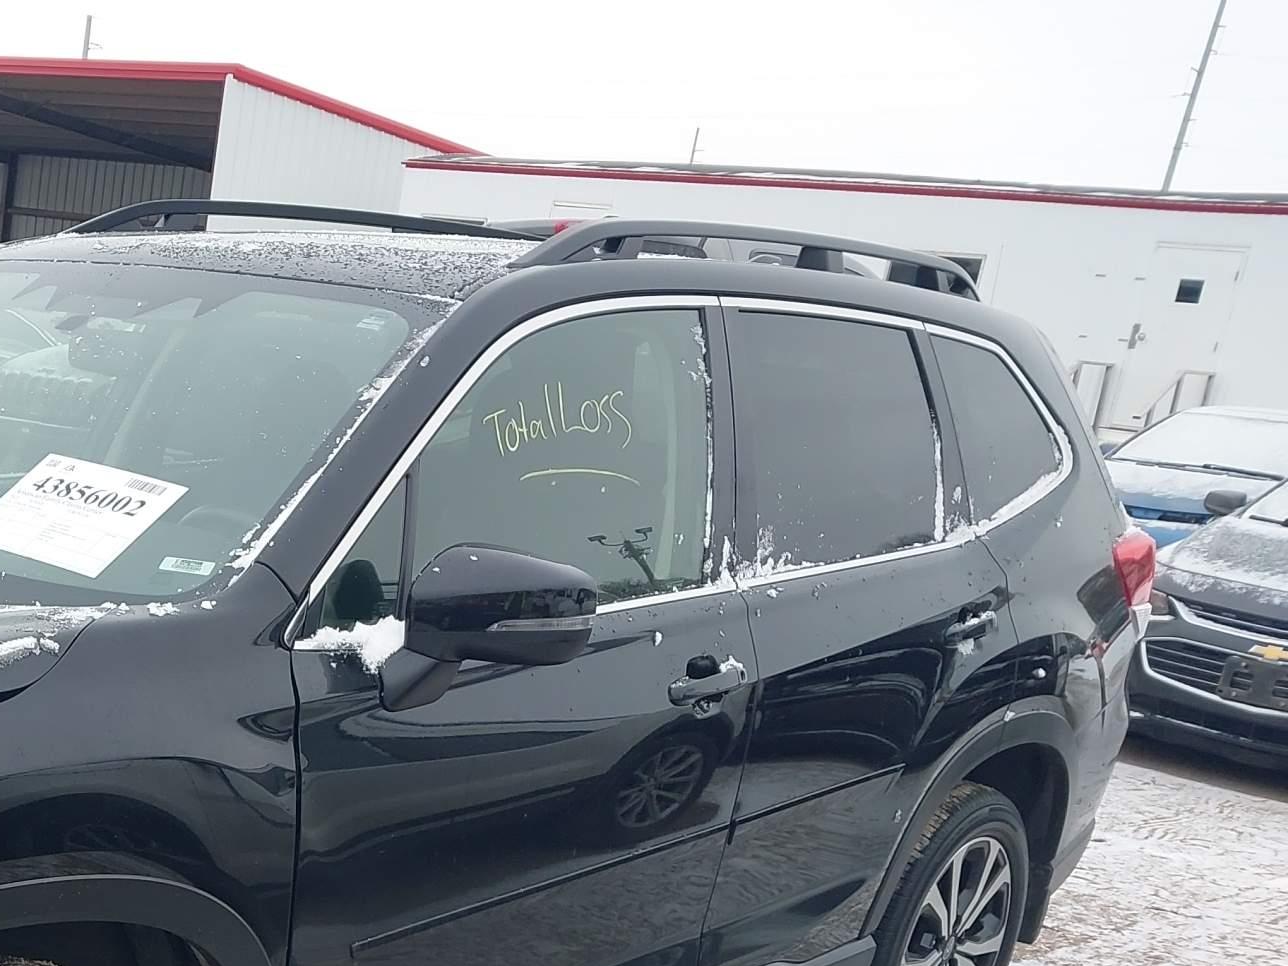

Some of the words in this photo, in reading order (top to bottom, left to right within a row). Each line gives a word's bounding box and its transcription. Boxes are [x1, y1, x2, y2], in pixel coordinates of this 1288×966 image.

[482, 382, 557, 457] Total
[558, 380, 632, 449] Loss
[32, 475, 147, 517] 43856002
